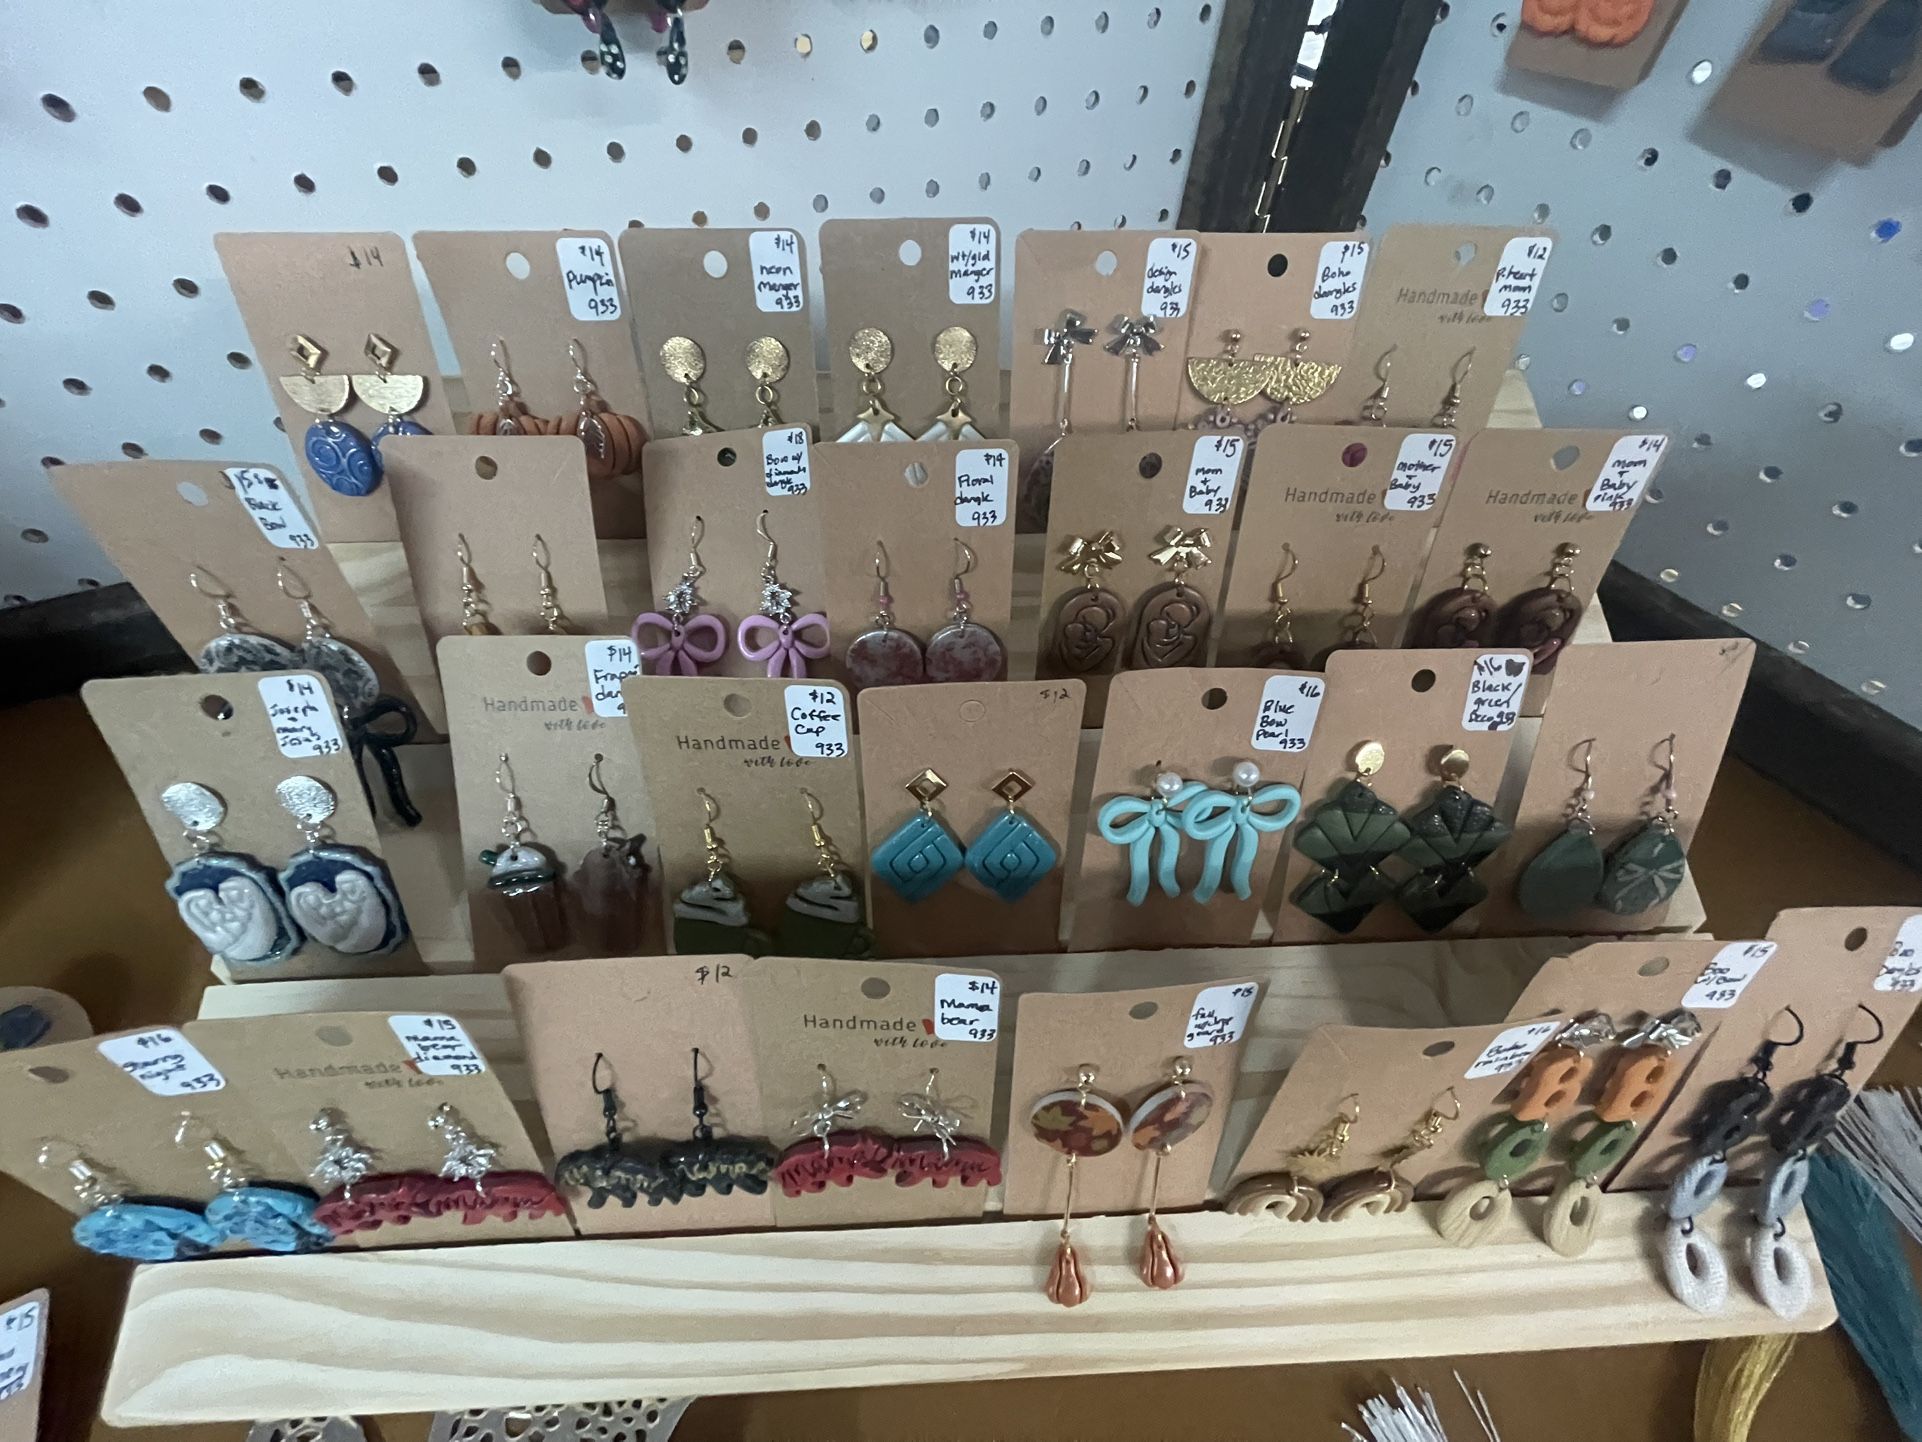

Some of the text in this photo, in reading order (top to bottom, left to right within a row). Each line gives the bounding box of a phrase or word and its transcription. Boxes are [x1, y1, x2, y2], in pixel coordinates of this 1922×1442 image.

[774, 234, 795, 254] $14
[969, 228, 990, 244] $14
[1171, 242, 1192, 260] $15
[1341, 241, 1365, 263] $15
[760, 265, 793, 276] neon
[967, 283, 993, 300] 933
[1396, 288, 1477, 306] Handmade
[588, 297, 617, 316] 933
[775, 295, 801, 310] 933
[1160, 301, 1180, 317] 933
[1330, 300, 1355, 316] 933
[1501, 298, 1530, 316] 933
[1214, 436, 1241, 458] $15
[1428, 438, 1454, 458] $15
[1638, 436, 1666, 453] $14
[984, 452, 1006, 468] $14
[787, 482, 808, 496] 933
[1189, 485, 1221, 499] Baby
[1389, 478, 1422, 494] Baby
[1600, 478, 1638, 496] Baby
[1284, 487, 1376, 505] Handmade
[1407, 492, 1437, 509] 933
[1485, 489, 1579, 505] Handmade
[1204, 497, 1229, 513] 933
[1609, 498, 1634, 511] 933
[972, 510, 998, 527] 933
[289, 533, 315, 549] 933
[606, 645, 632, 663] $14
[286, 679, 315, 696] $14
[1299, 681, 1321, 697] $16
[483, 697, 579, 712] Handmade
[808, 689, 836, 704] $12
[1262, 700, 1295, 714] Blue
[1260, 715, 1287, 728] Bow
[795, 724, 825, 737] Cup
[312, 738, 341, 755] 933
[676, 735, 781, 750] Handmade
[815, 742, 845, 757] 933
[1279, 738, 1306, 750] 933
[744, 756, 774, 768] with
[968, 980, 998, 995] $14
[1232, 987, 1254, 997] $15
[940, 999, 993, 1012] Mama
[423, 1018, 456, 1030] $15
[803, 1014, 917, 1032] Handmade
[941, 1012, 980, 1025] bear
[137, 1033, 173, 1048] $16
[969, 1028, 996, 1040] 933
[1209, 1032, 1235, 1045] 933
[873, 1037, 906, 1048] with
[273, 1062, 401, 1079] Handmade
[450, 1064, 481, 1075] 933
[181, 1073, 220, 1090] 933
